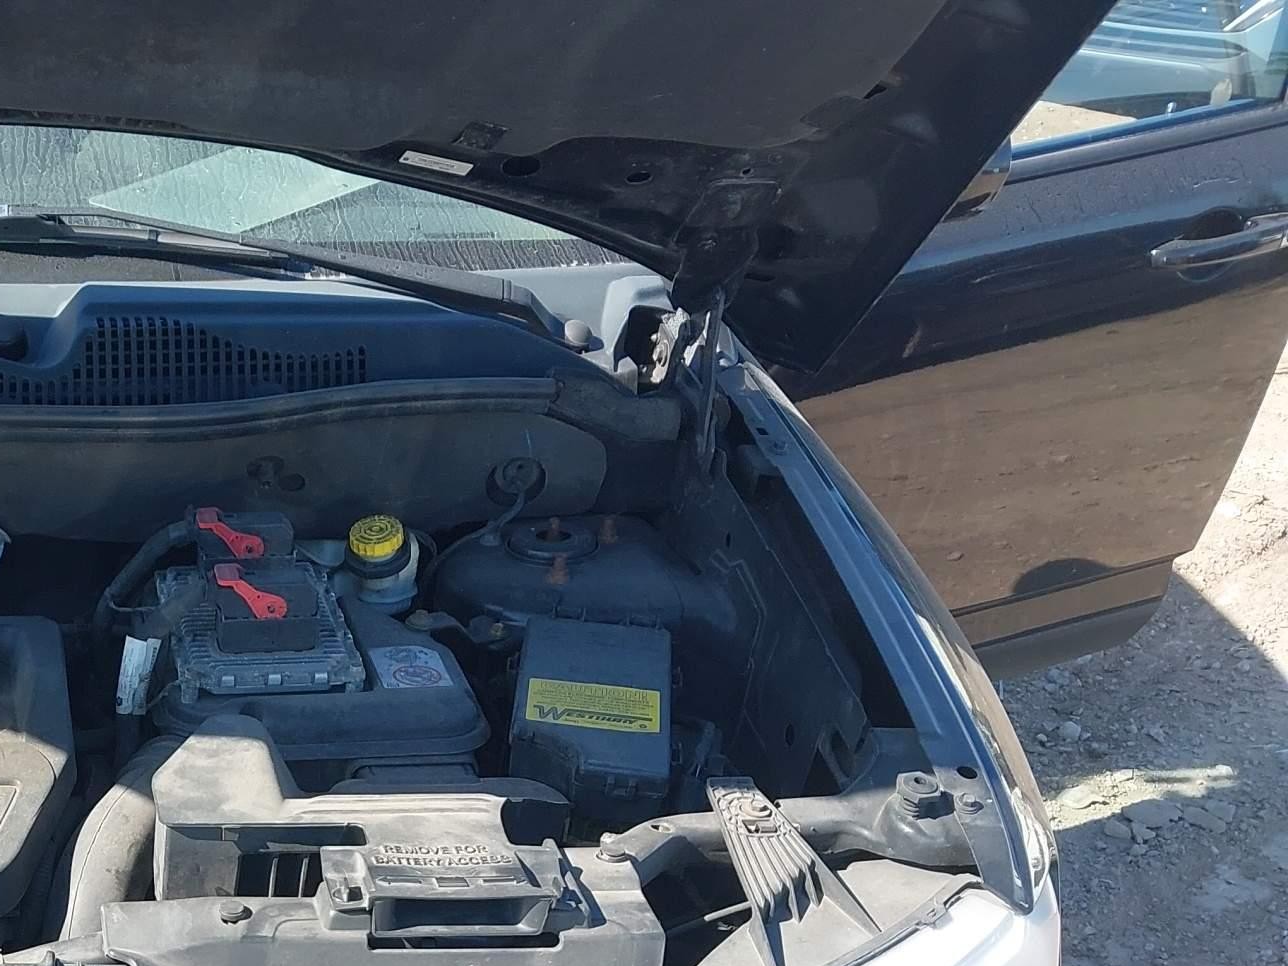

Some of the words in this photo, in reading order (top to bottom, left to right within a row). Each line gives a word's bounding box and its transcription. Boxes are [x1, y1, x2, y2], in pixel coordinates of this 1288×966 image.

[382, 844, 452, 855] REMOVE
[454, 843, 489, 855] FOR
[373, 855, 443, 867] BATTERY
[446, 855, 513, 866] ACCESS
